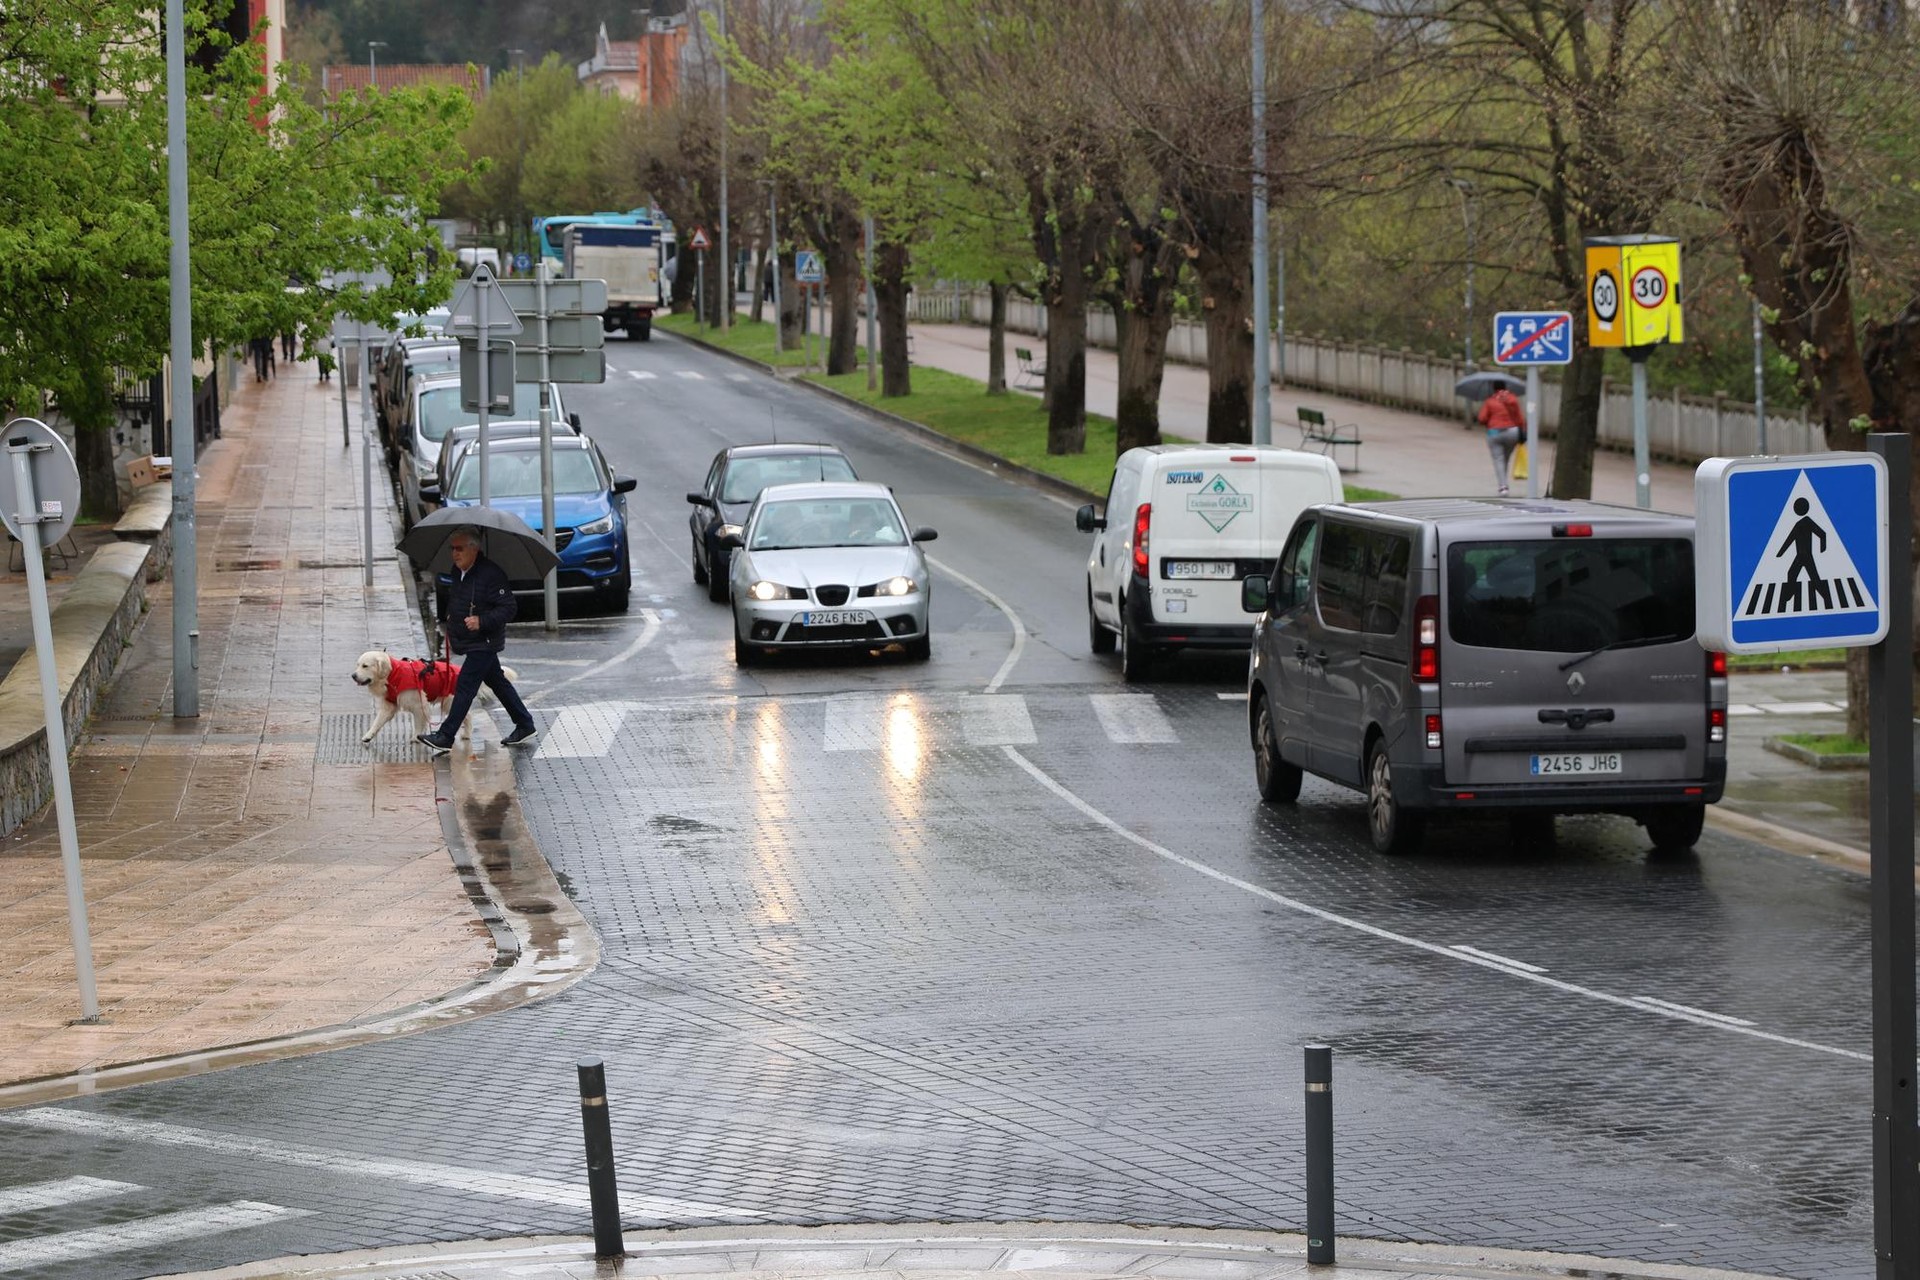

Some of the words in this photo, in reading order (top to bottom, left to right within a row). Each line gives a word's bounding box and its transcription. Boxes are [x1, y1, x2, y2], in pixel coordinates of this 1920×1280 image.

[1637, 277, 1662, 297] 30
[1597, 285, 1613, 306] 30
[1218, 497, 1248, 508] GORLA
[1176, 563, 1205, 574] 9501
[1209, 563, 1233, 574] JNT
[810, 613, 839, 624] 2246
[1543, 756, 1582, 772] 2456
[1588, 755, 1617, 771] JHG
